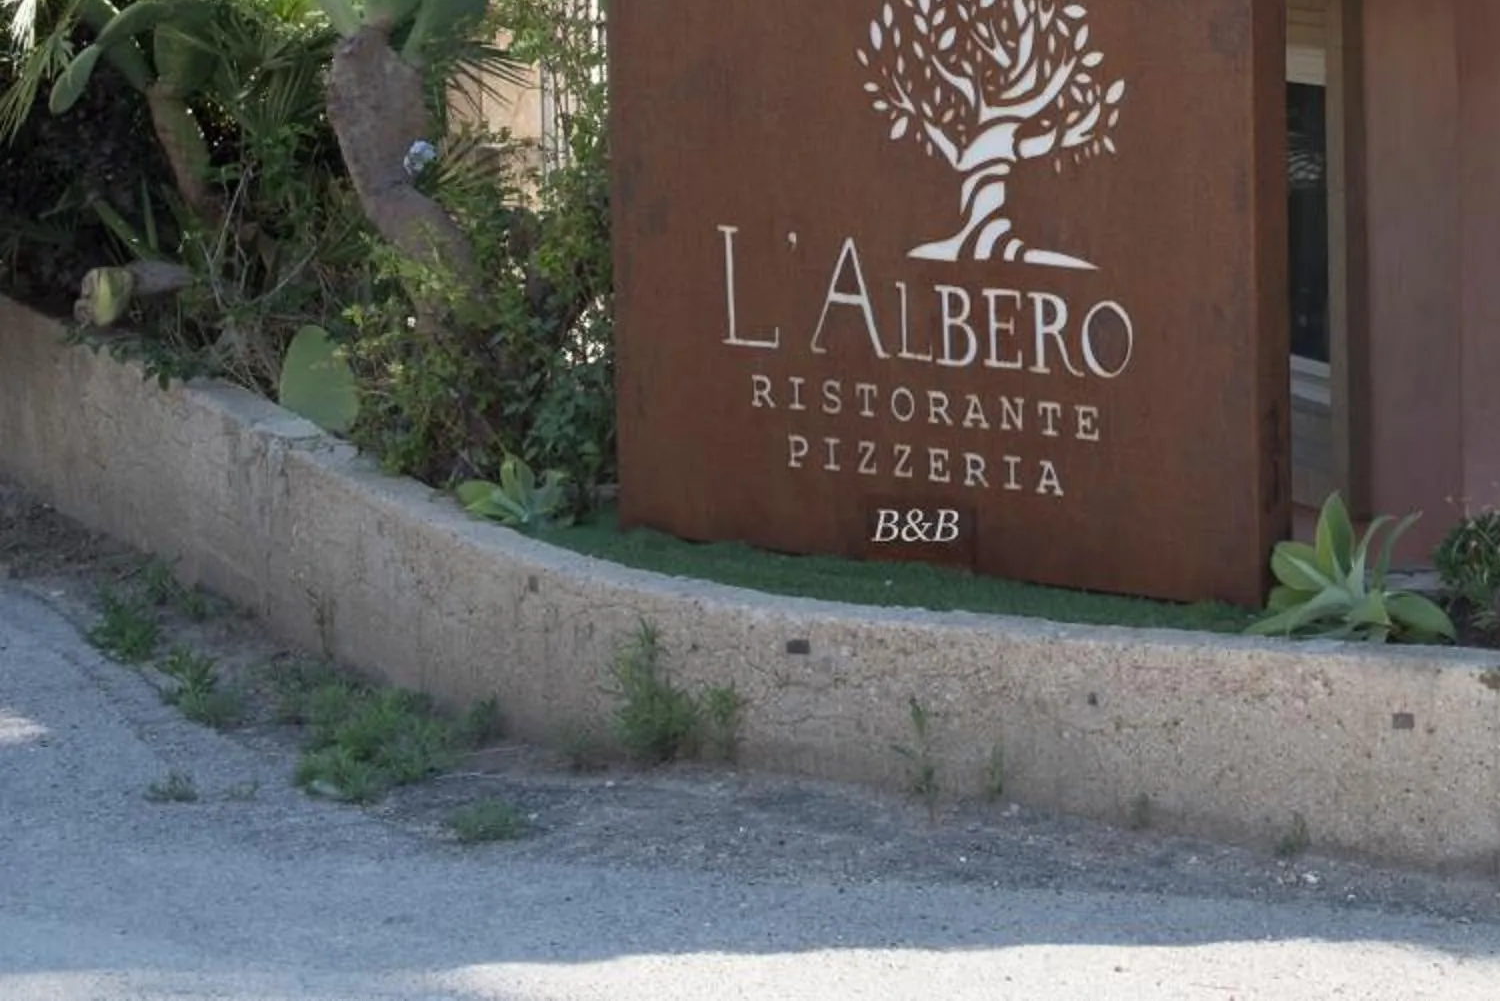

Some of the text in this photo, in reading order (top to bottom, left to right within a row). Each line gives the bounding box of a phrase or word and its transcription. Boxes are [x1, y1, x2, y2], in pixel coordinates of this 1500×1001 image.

[718, 225, 1134, 378] L'ALBERO
[751, 375, 1100, 441] RISTORANTE
[787, 436, 1065, 497] PIZZERIA
[871, 509, 961, 543] B&B
